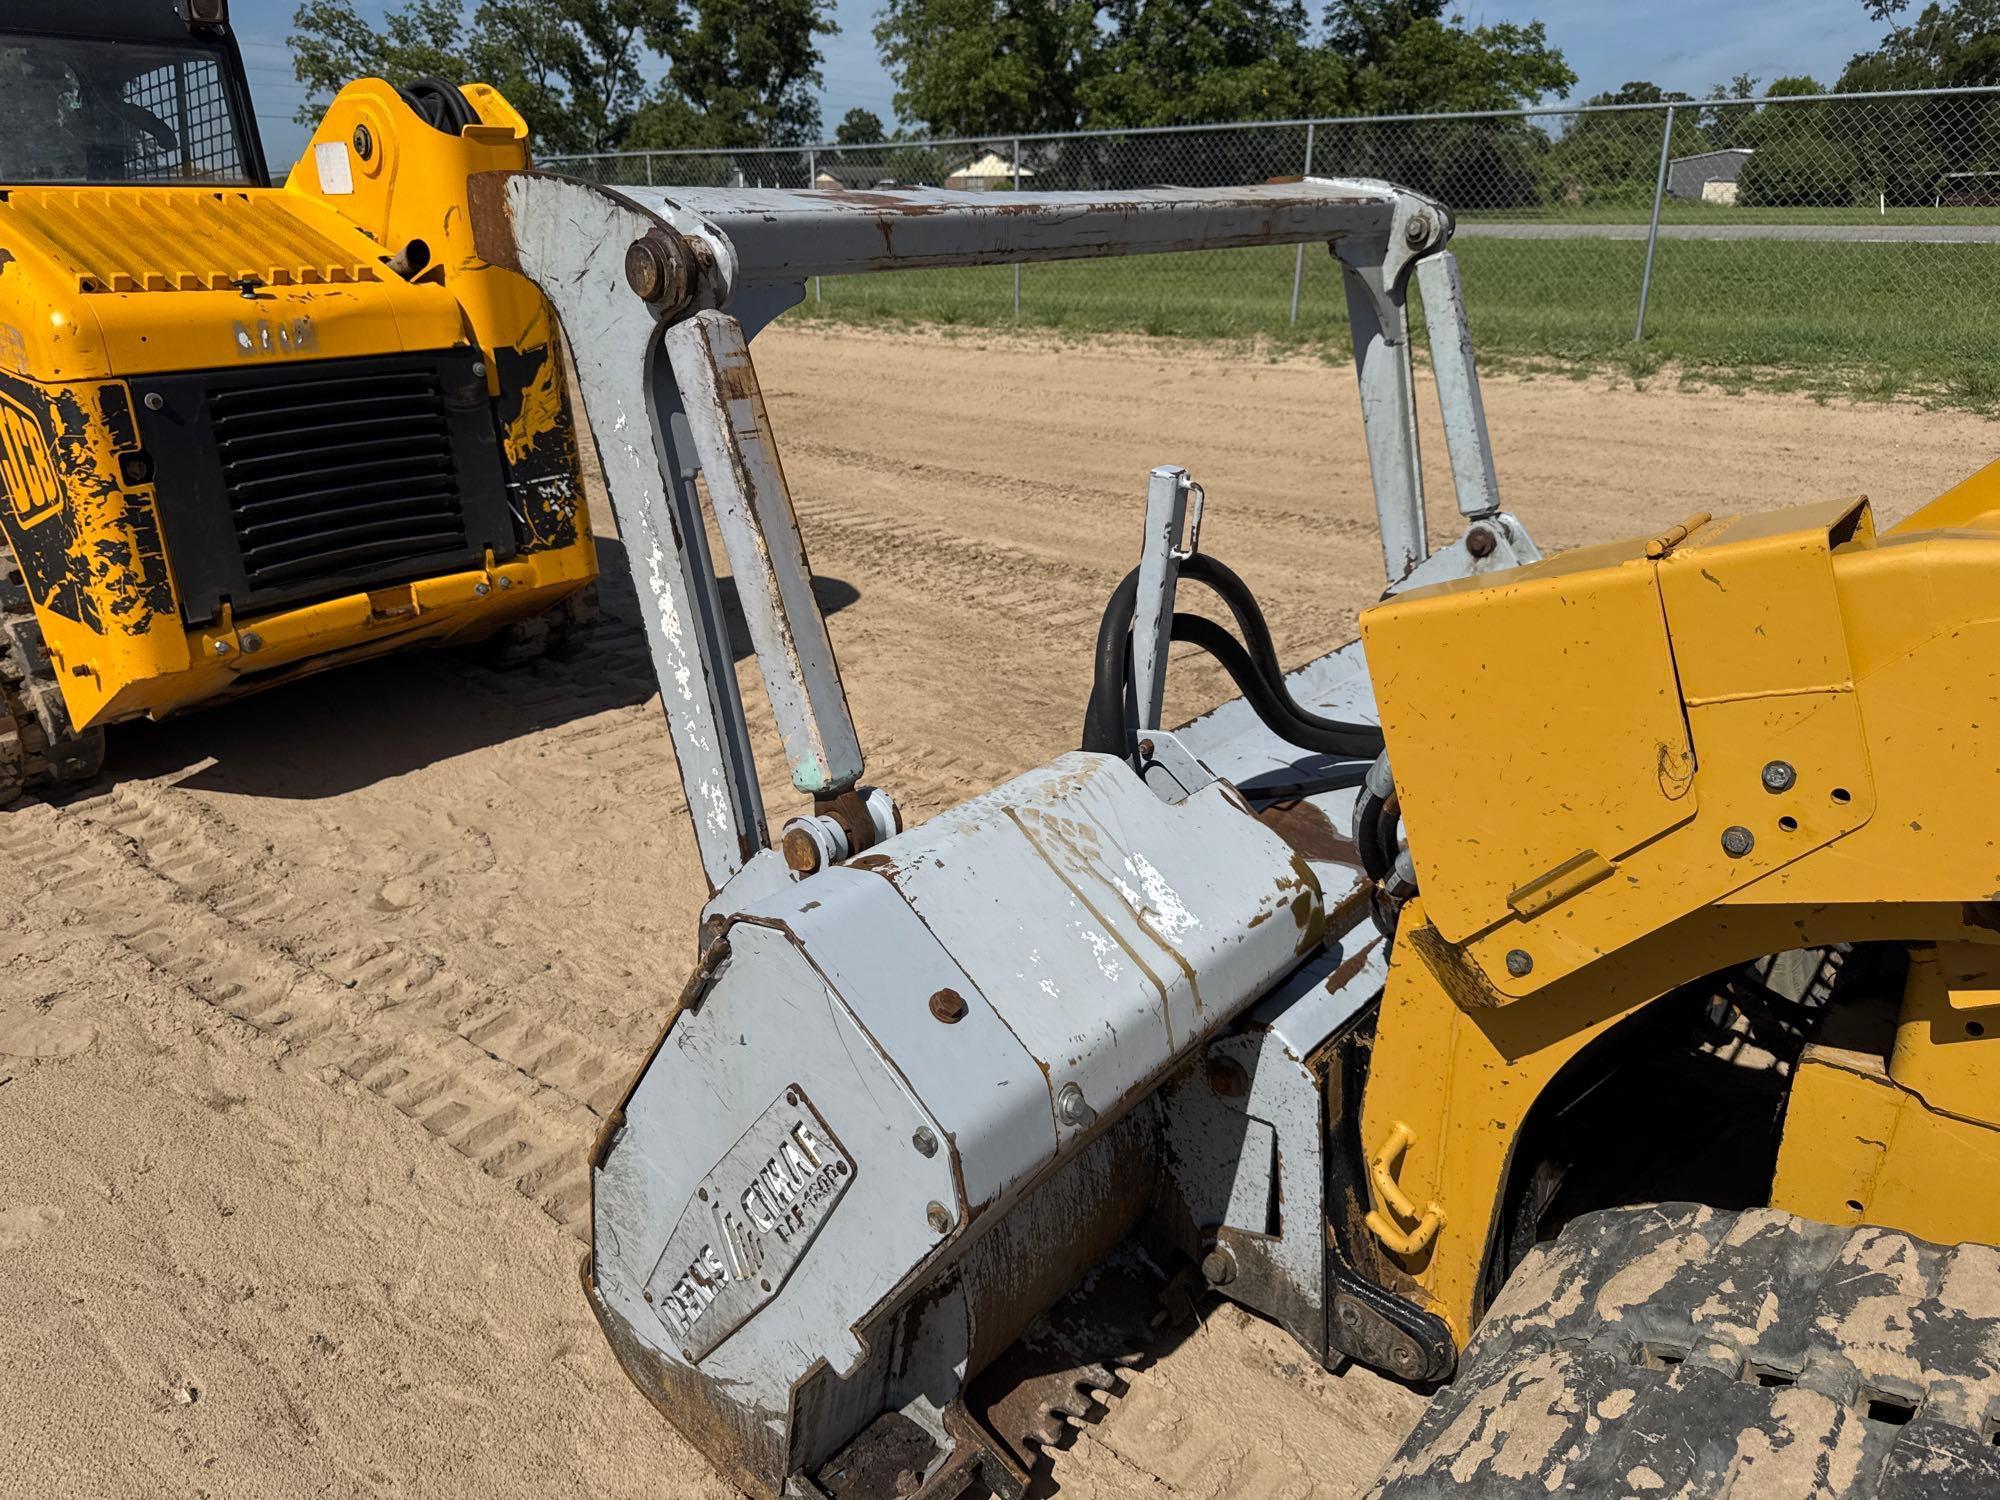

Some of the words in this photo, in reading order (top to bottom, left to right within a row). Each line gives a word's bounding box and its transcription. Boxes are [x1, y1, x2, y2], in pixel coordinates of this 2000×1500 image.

[0, 403, 57, 513] JCB
[660, 1243, 730, 1337] DENIS
[740, 1119, 823, 1234] CIMAF
